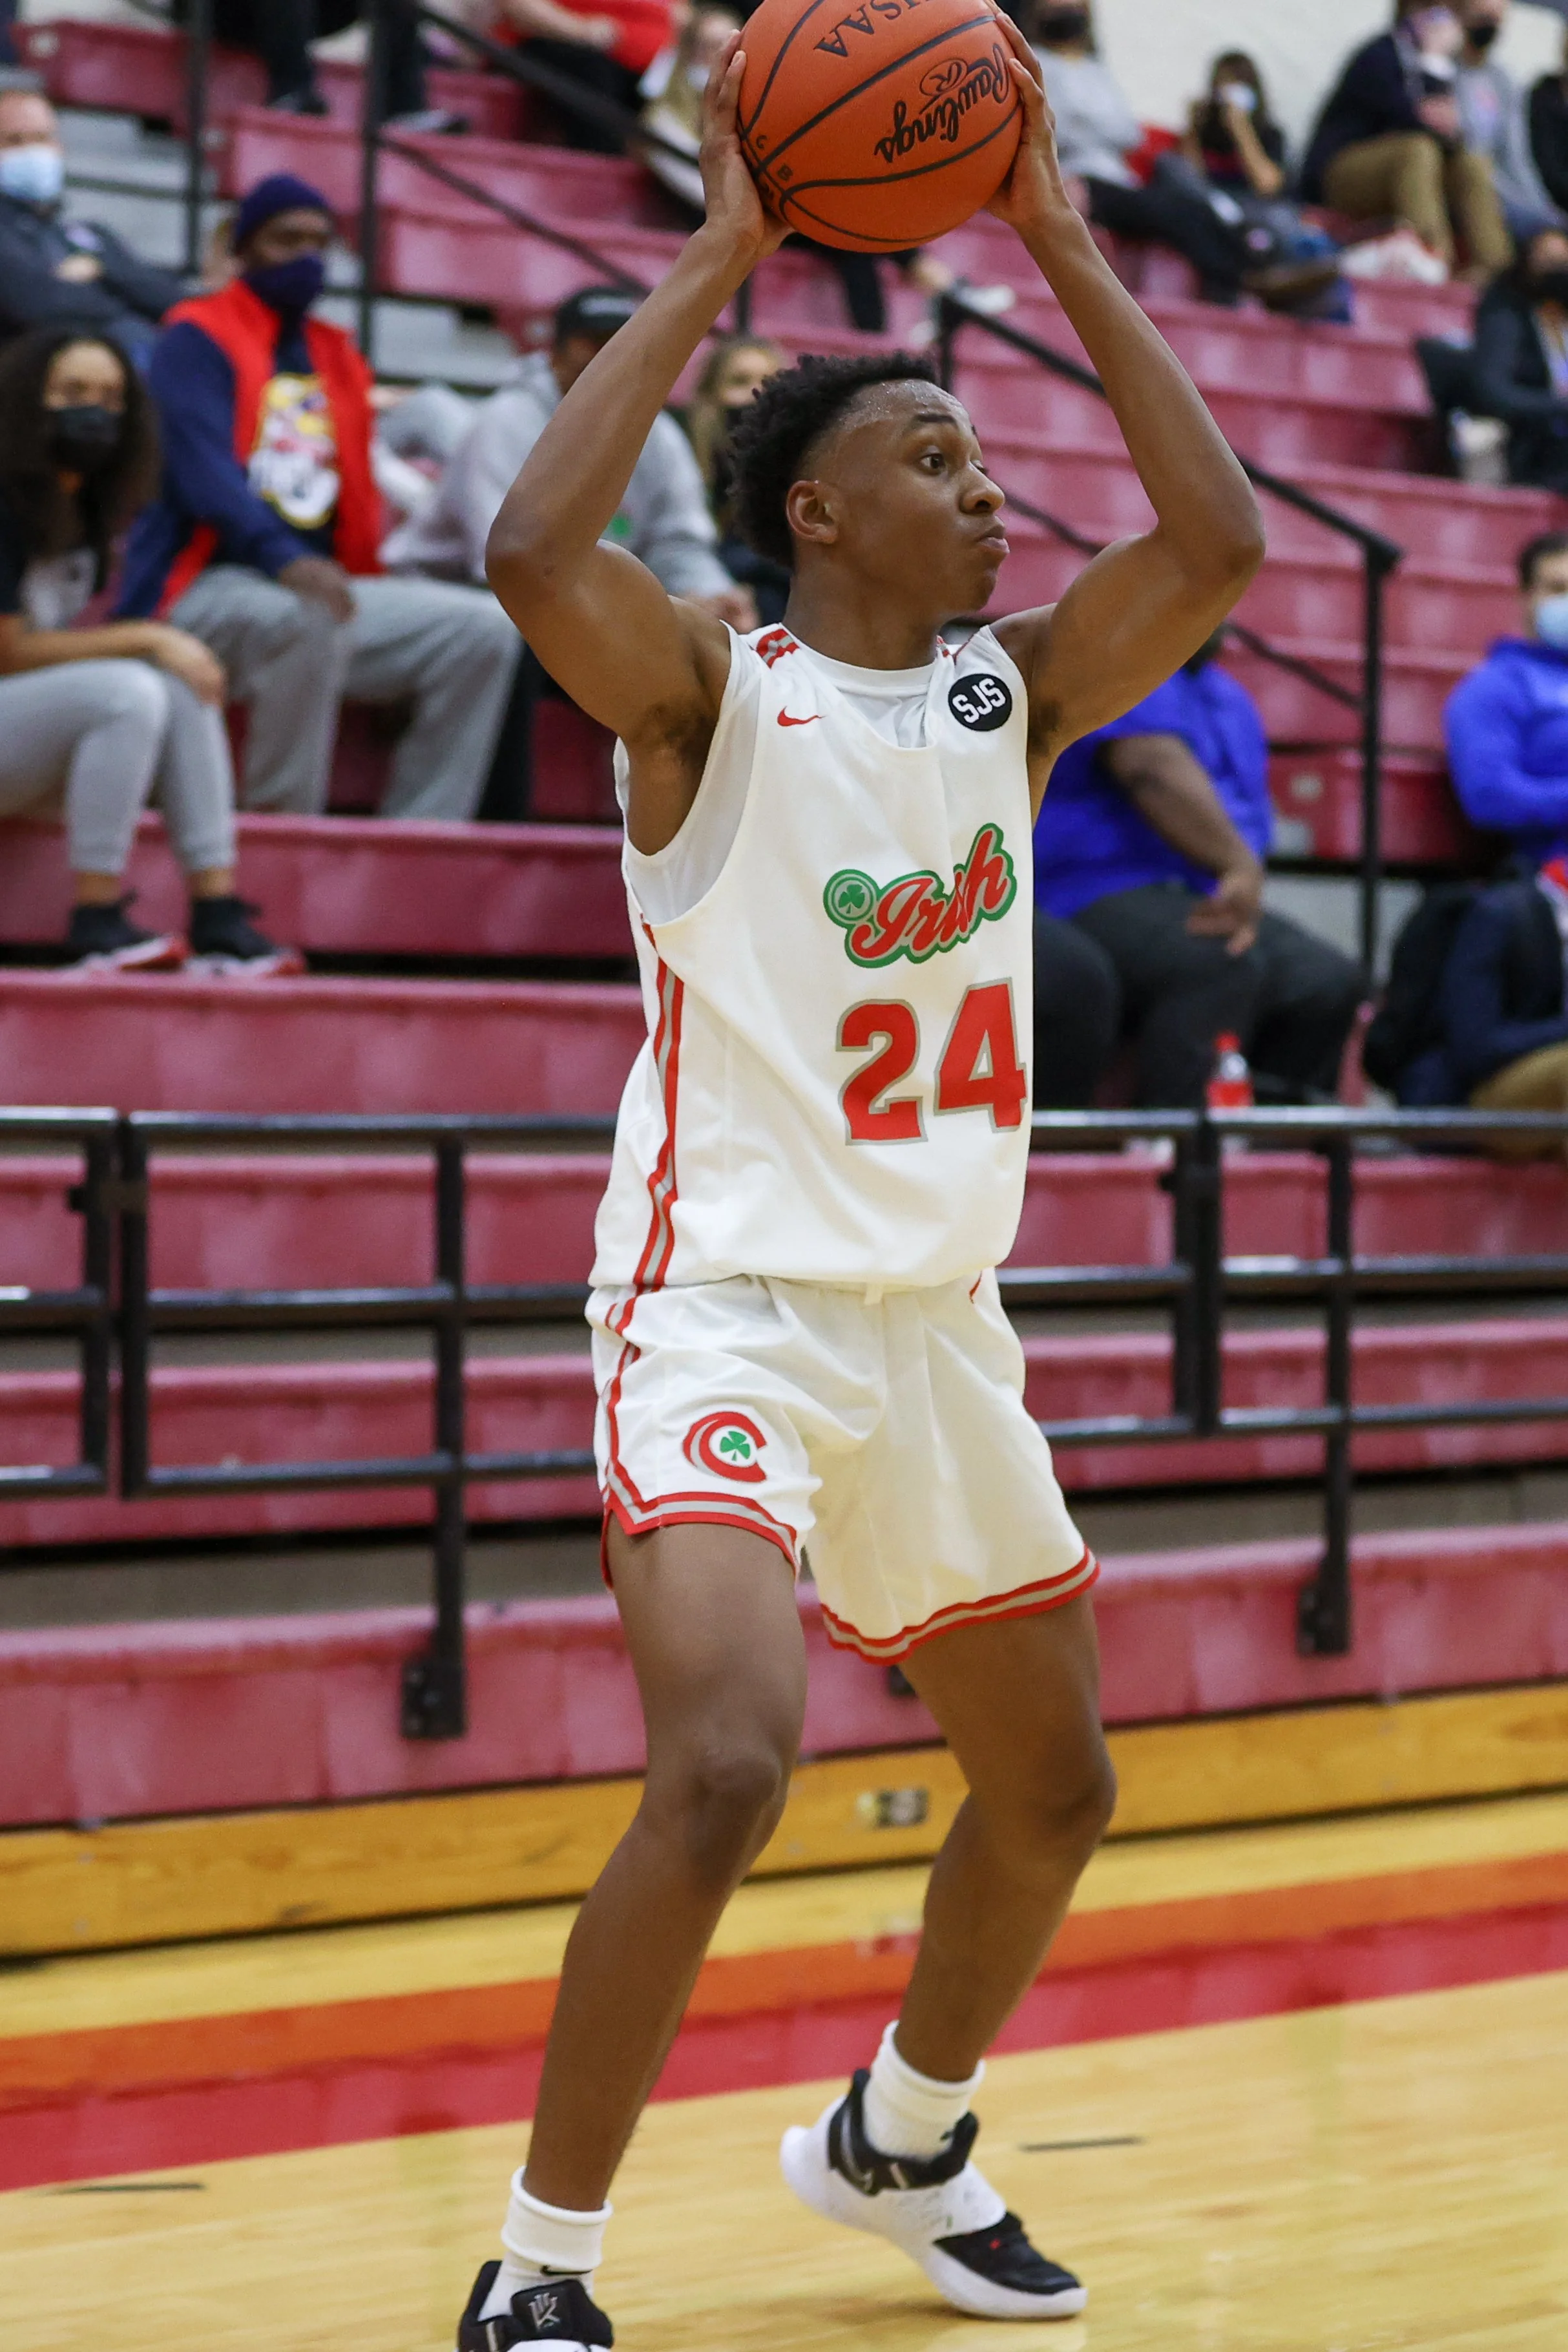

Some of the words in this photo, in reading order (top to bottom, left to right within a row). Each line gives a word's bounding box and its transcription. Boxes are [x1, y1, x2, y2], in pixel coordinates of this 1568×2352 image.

[813, 0, 928, 58] SAA
[873, 43, 1009, 163] Rawlings
[952, 678, 1006, 724] SJS
[835, 976, 1028, 1146] 24
